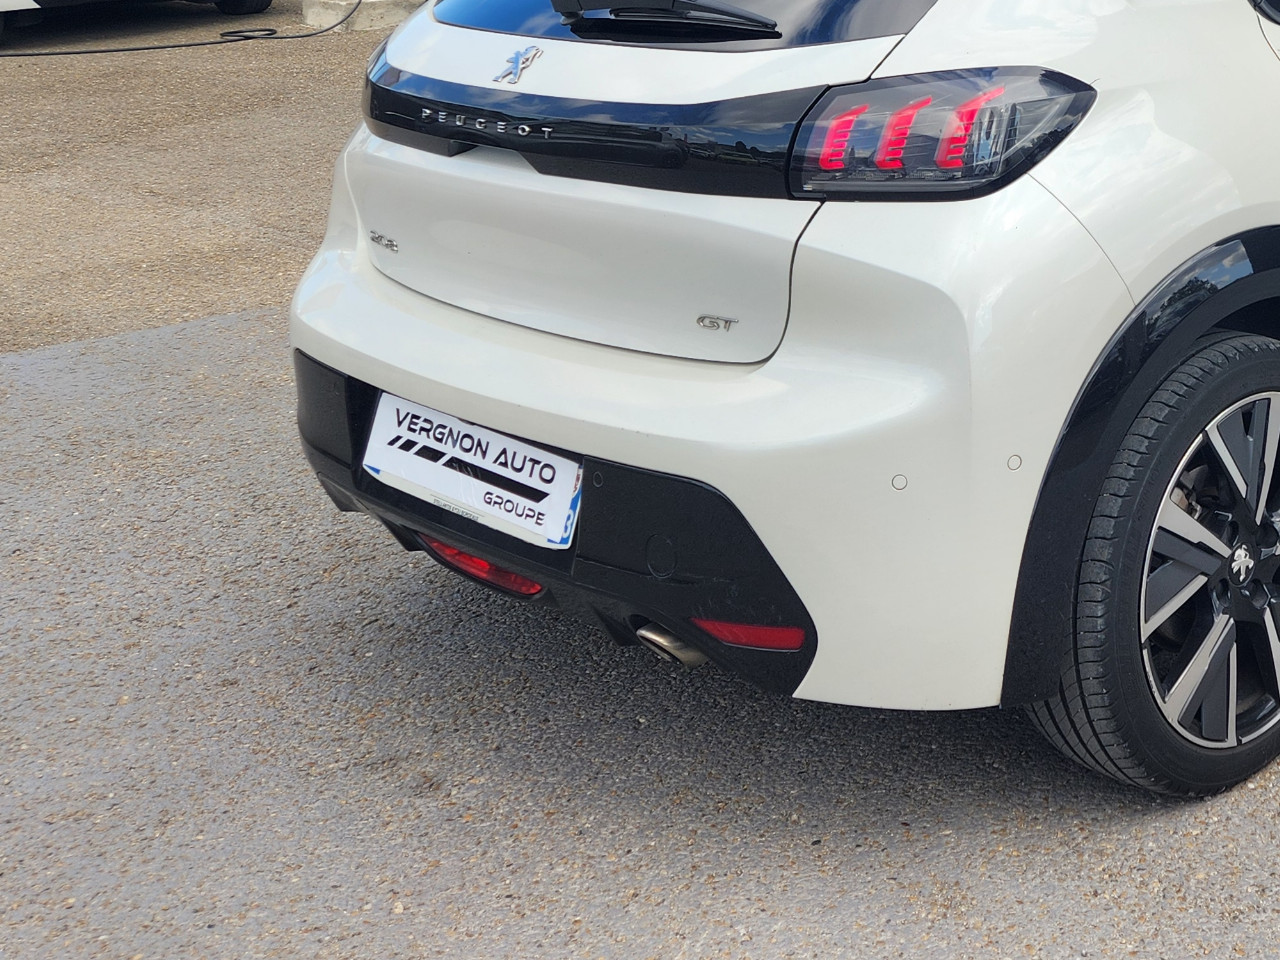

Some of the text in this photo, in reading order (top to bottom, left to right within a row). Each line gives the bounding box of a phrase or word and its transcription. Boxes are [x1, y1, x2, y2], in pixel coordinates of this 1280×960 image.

[421, 108, 553, 139] PEUGEOT
[696, 314, 739, 332] GT
[395, 408, 490, 460] VERGNON
[493, 447, 557, 485] AUTO
[483, 491, 546, 527] GROUPE
